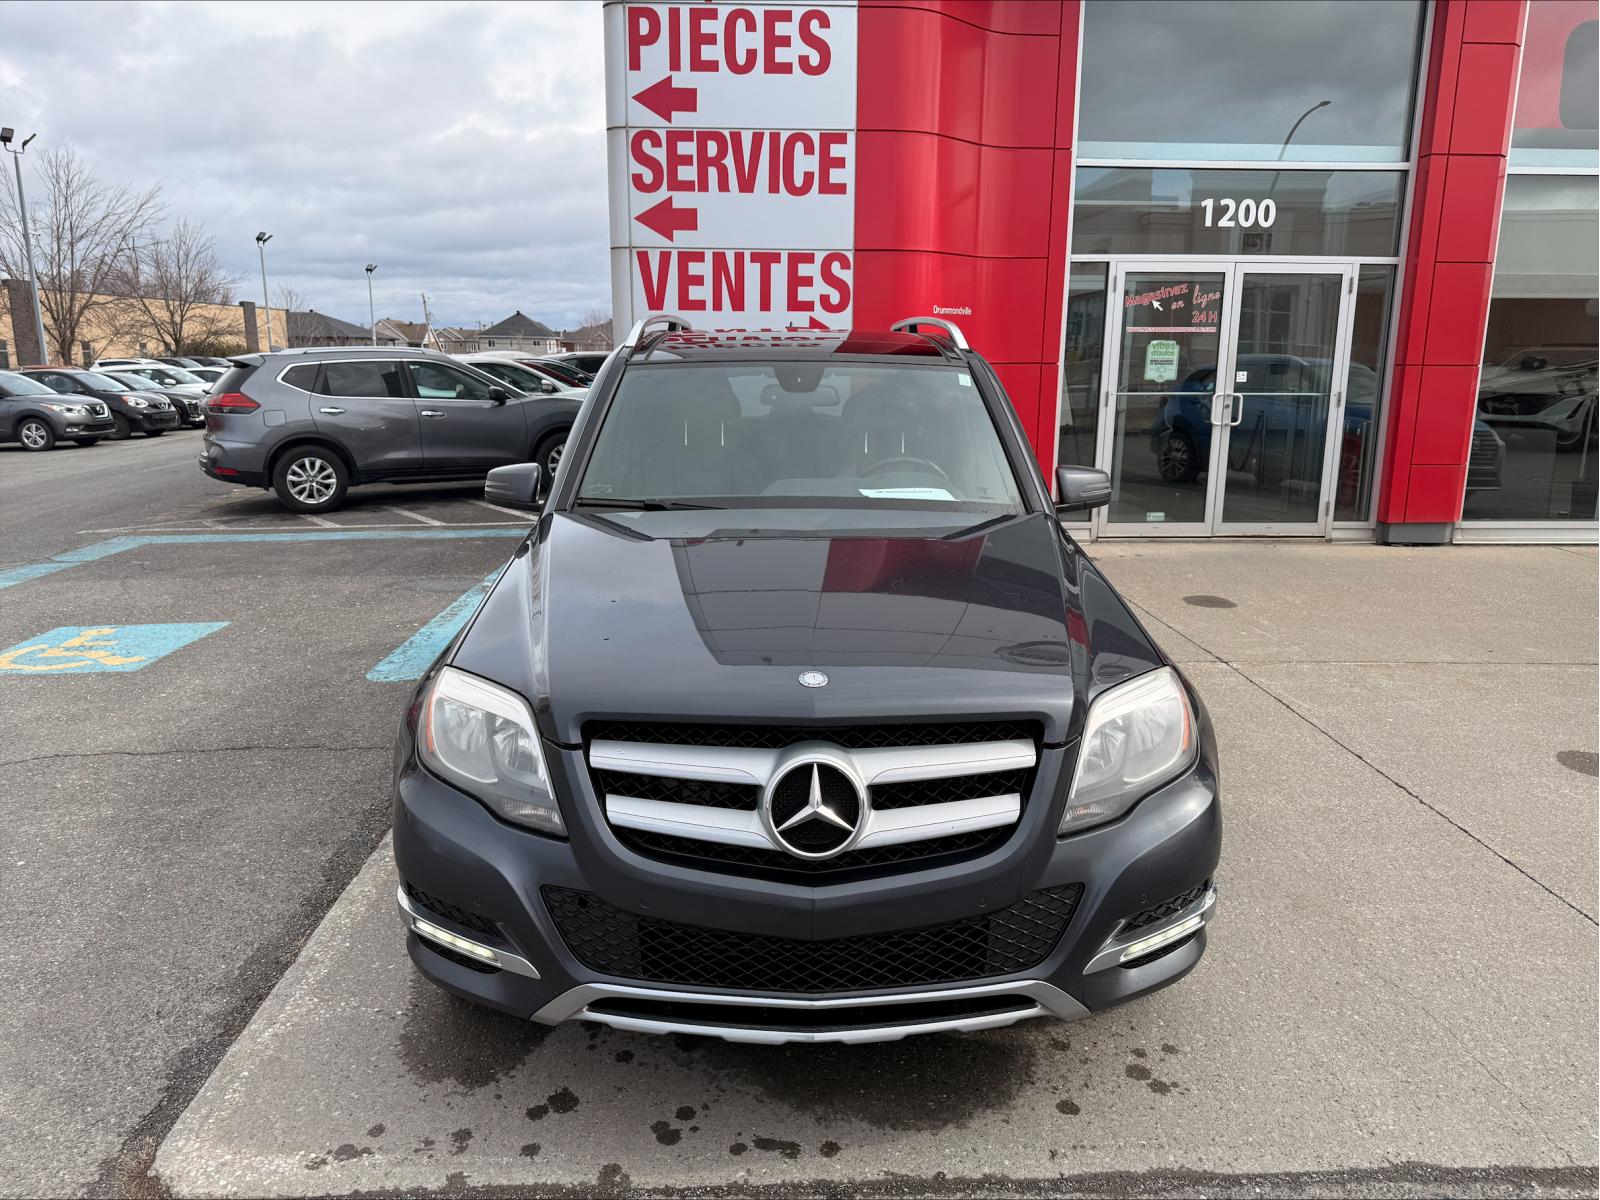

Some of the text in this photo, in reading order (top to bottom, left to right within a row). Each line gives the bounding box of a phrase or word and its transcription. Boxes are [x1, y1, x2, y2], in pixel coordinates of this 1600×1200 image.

[630, 129, 848, 197] SERVICE
[1200, 198, 1277, 228] 1200
[636, 250, 852, 314] VENTES
[1124, 283, 1221, 310] Magasinez en ligne
[933, 305, 972, 315] Drummondville
